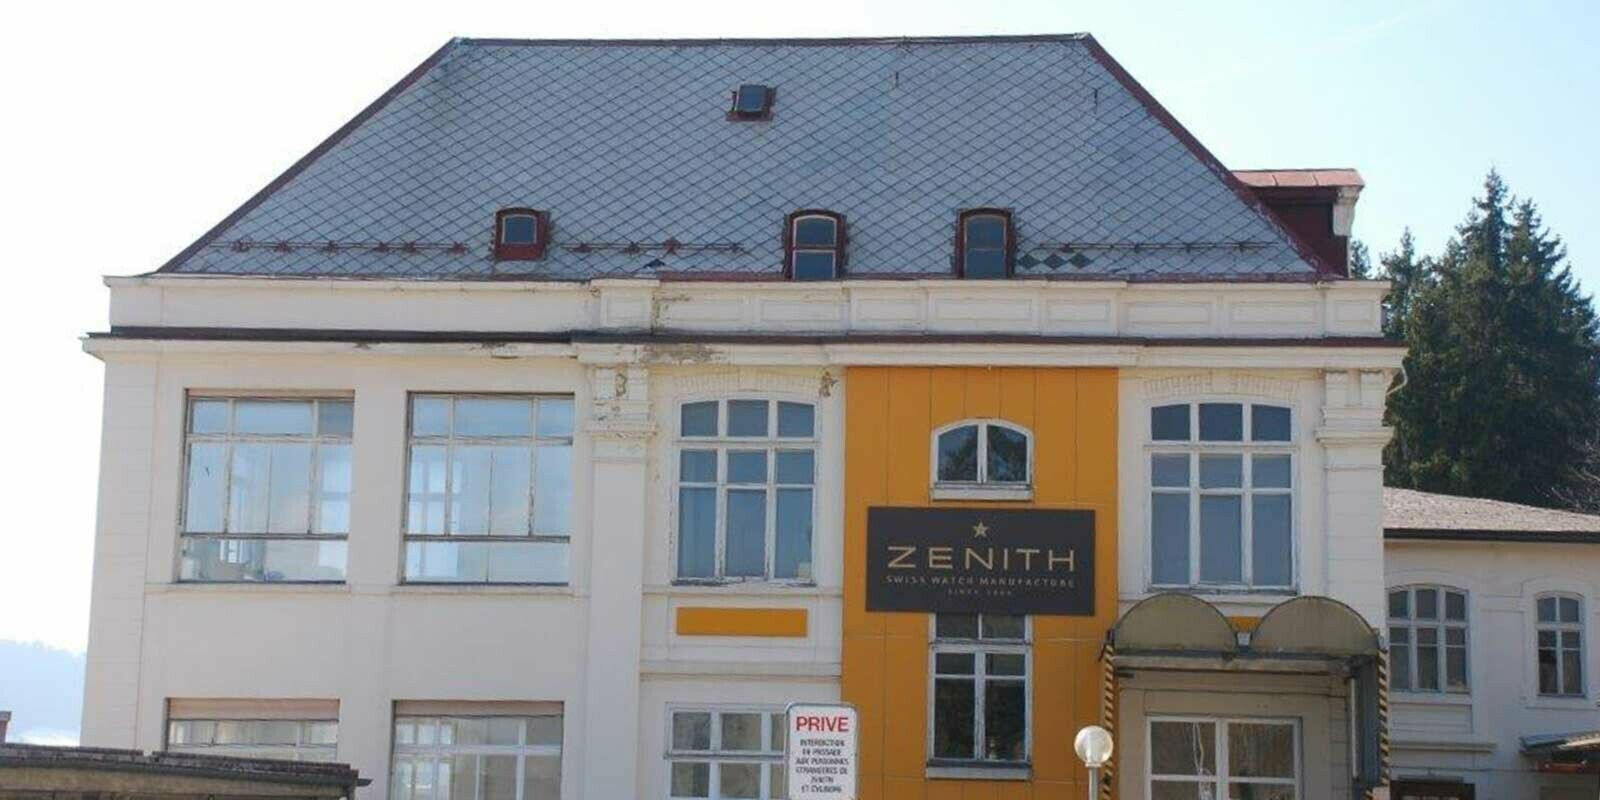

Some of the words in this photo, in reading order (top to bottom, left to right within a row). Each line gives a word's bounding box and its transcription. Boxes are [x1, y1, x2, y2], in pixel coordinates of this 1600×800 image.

[887, 546, 1075, 571] ZENITH
[886, 575, 925, 584] SWISS
[931, 575, 973, 586] WATCH
[979, 576, 1075, 588] MANUFACTURE
[796, 716, 849, 732] PRIVE
